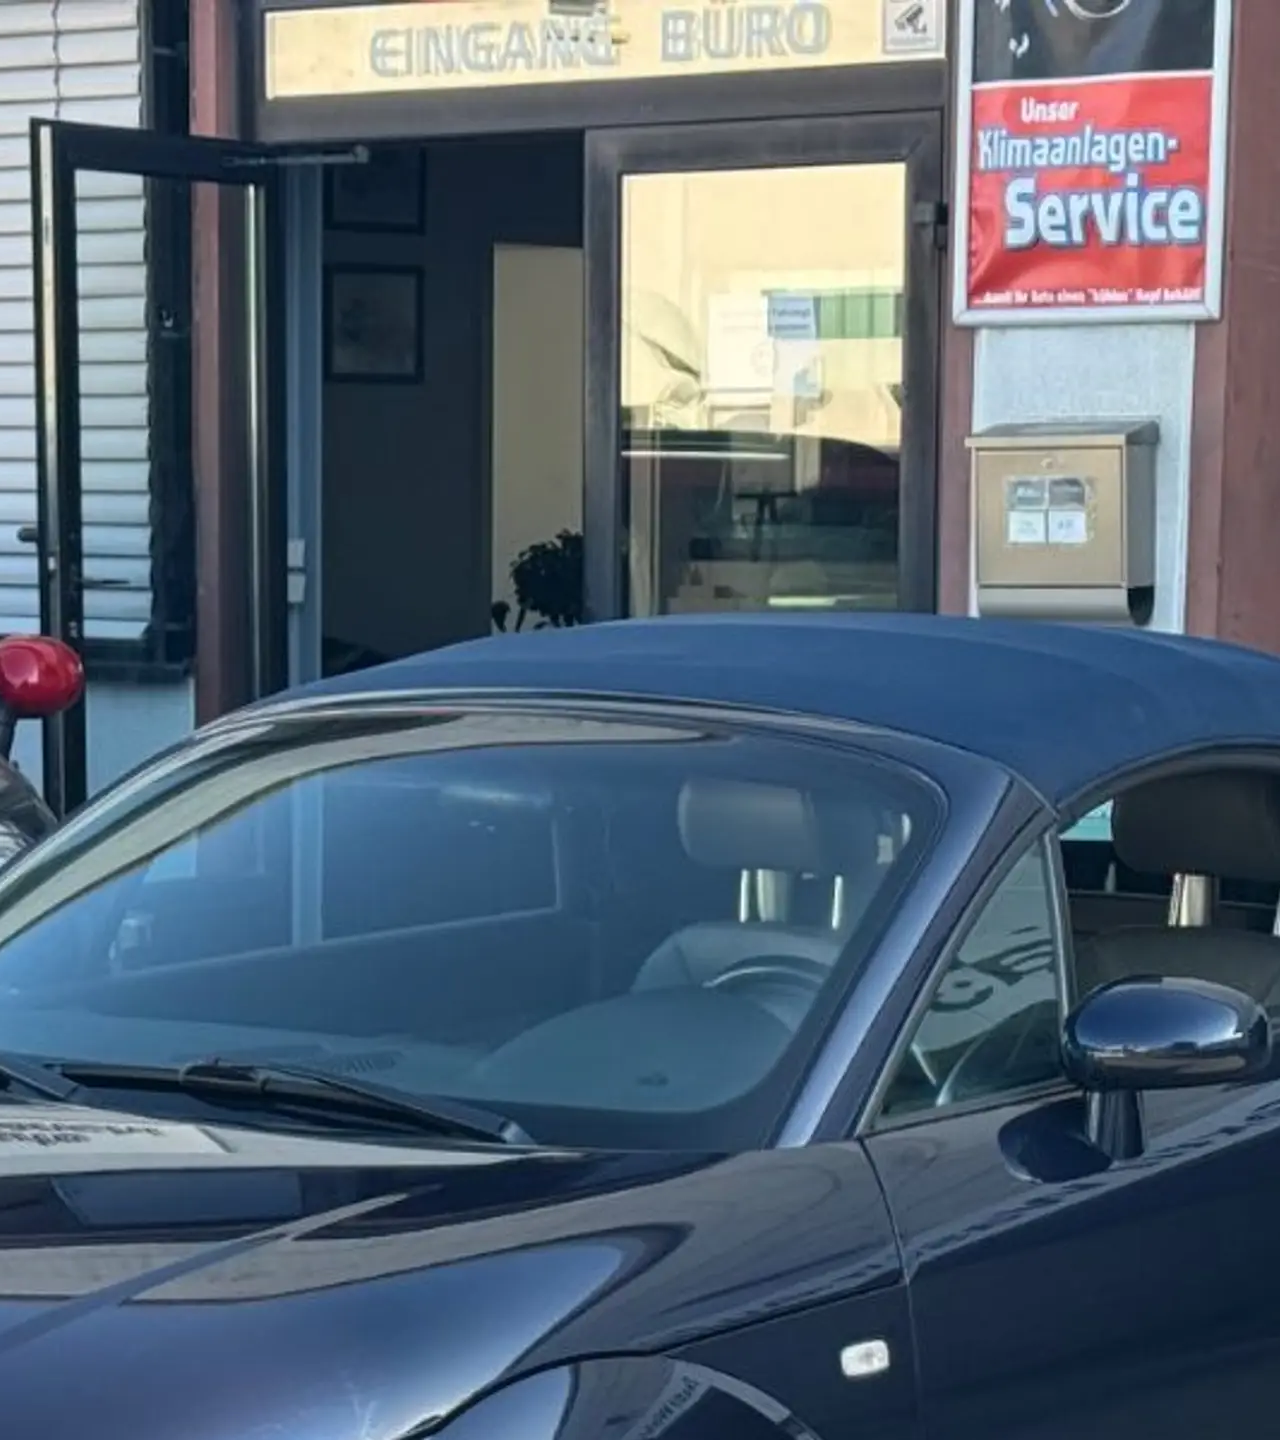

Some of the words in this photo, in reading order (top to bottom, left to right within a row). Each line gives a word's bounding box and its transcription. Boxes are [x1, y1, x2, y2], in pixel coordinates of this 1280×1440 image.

[369, 16, 622, 78] EINGANG
[1021, 97, 1080, 123] Unser
[977, 124, 1180, 173] Klimaanlagen-
[1004, 172, 1203, 248] Service
